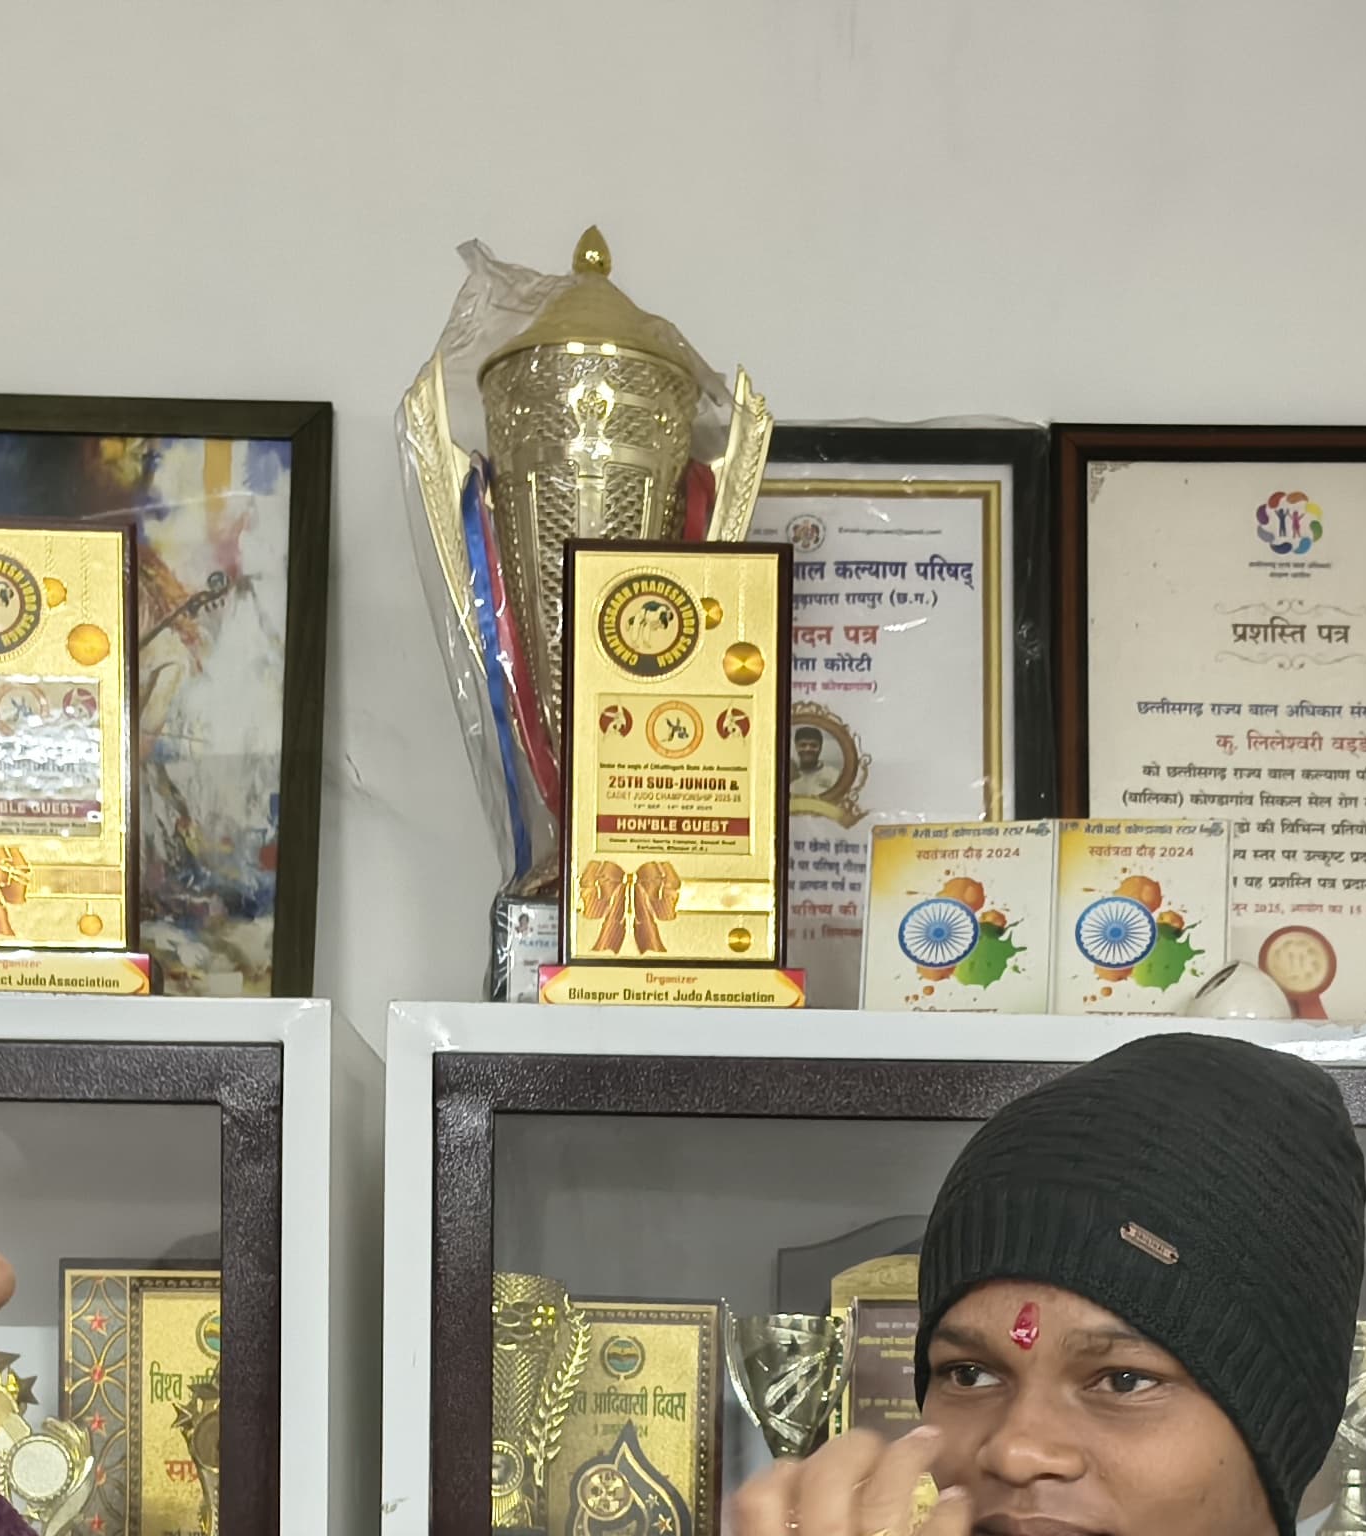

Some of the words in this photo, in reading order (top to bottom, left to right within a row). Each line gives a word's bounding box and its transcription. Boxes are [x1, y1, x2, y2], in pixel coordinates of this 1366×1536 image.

[834, 561, 907, 580] कल्याण
[915, 554, 974, 589] परिषद्
[844, 625, 879, 645] पत्र
[1232, 615, 1307, 644] प्रशस्ति
[1317, 625, 1351, 644] पत्र
[824, 653, 872, 672] कोरेटी
[1136, 697, 1204, 717] छत्तीसगढ़
[1210, 703, 1241, 716] राज्य
[1248, 704, 1278, 717] बाल
[1286, 700, 1343, 718] अधिकार
[1215, 734, 1238, 756] कु.
[1247, 728, 1323, 751] लिलेश्वरी
[1142, 761, 1160, 777] को
[1233, 767, 1262, 779] राज्य
[608, 775, 643, 789] 25TH
[647, 775, 726, 791] SUB-JUNIOR
[729, 779, 739, 791] &
[616, 818, 677, 832] HON'BLE
[681, 819, 730, 832] GUEST
[986, 847, 1020, 859] 2024
[1159, 847, 1194, 857] 2024
[17, 973, 46, 987] Judo
[49, 974, 120, 988] Association
[645, 973, 698, 985] Organizer
[568, 988, 619, 1003] Bilaspur
[623, 988, 669, 1002] District
[672, 990, 703, 1003] Judo
[705, 990, 775, 1004] Association
[150, 1361, 182, 1404] विश्व
[591, 1385, 648, 1417] आदिवासी
[653, 1386, 687, 1422] दिवस
